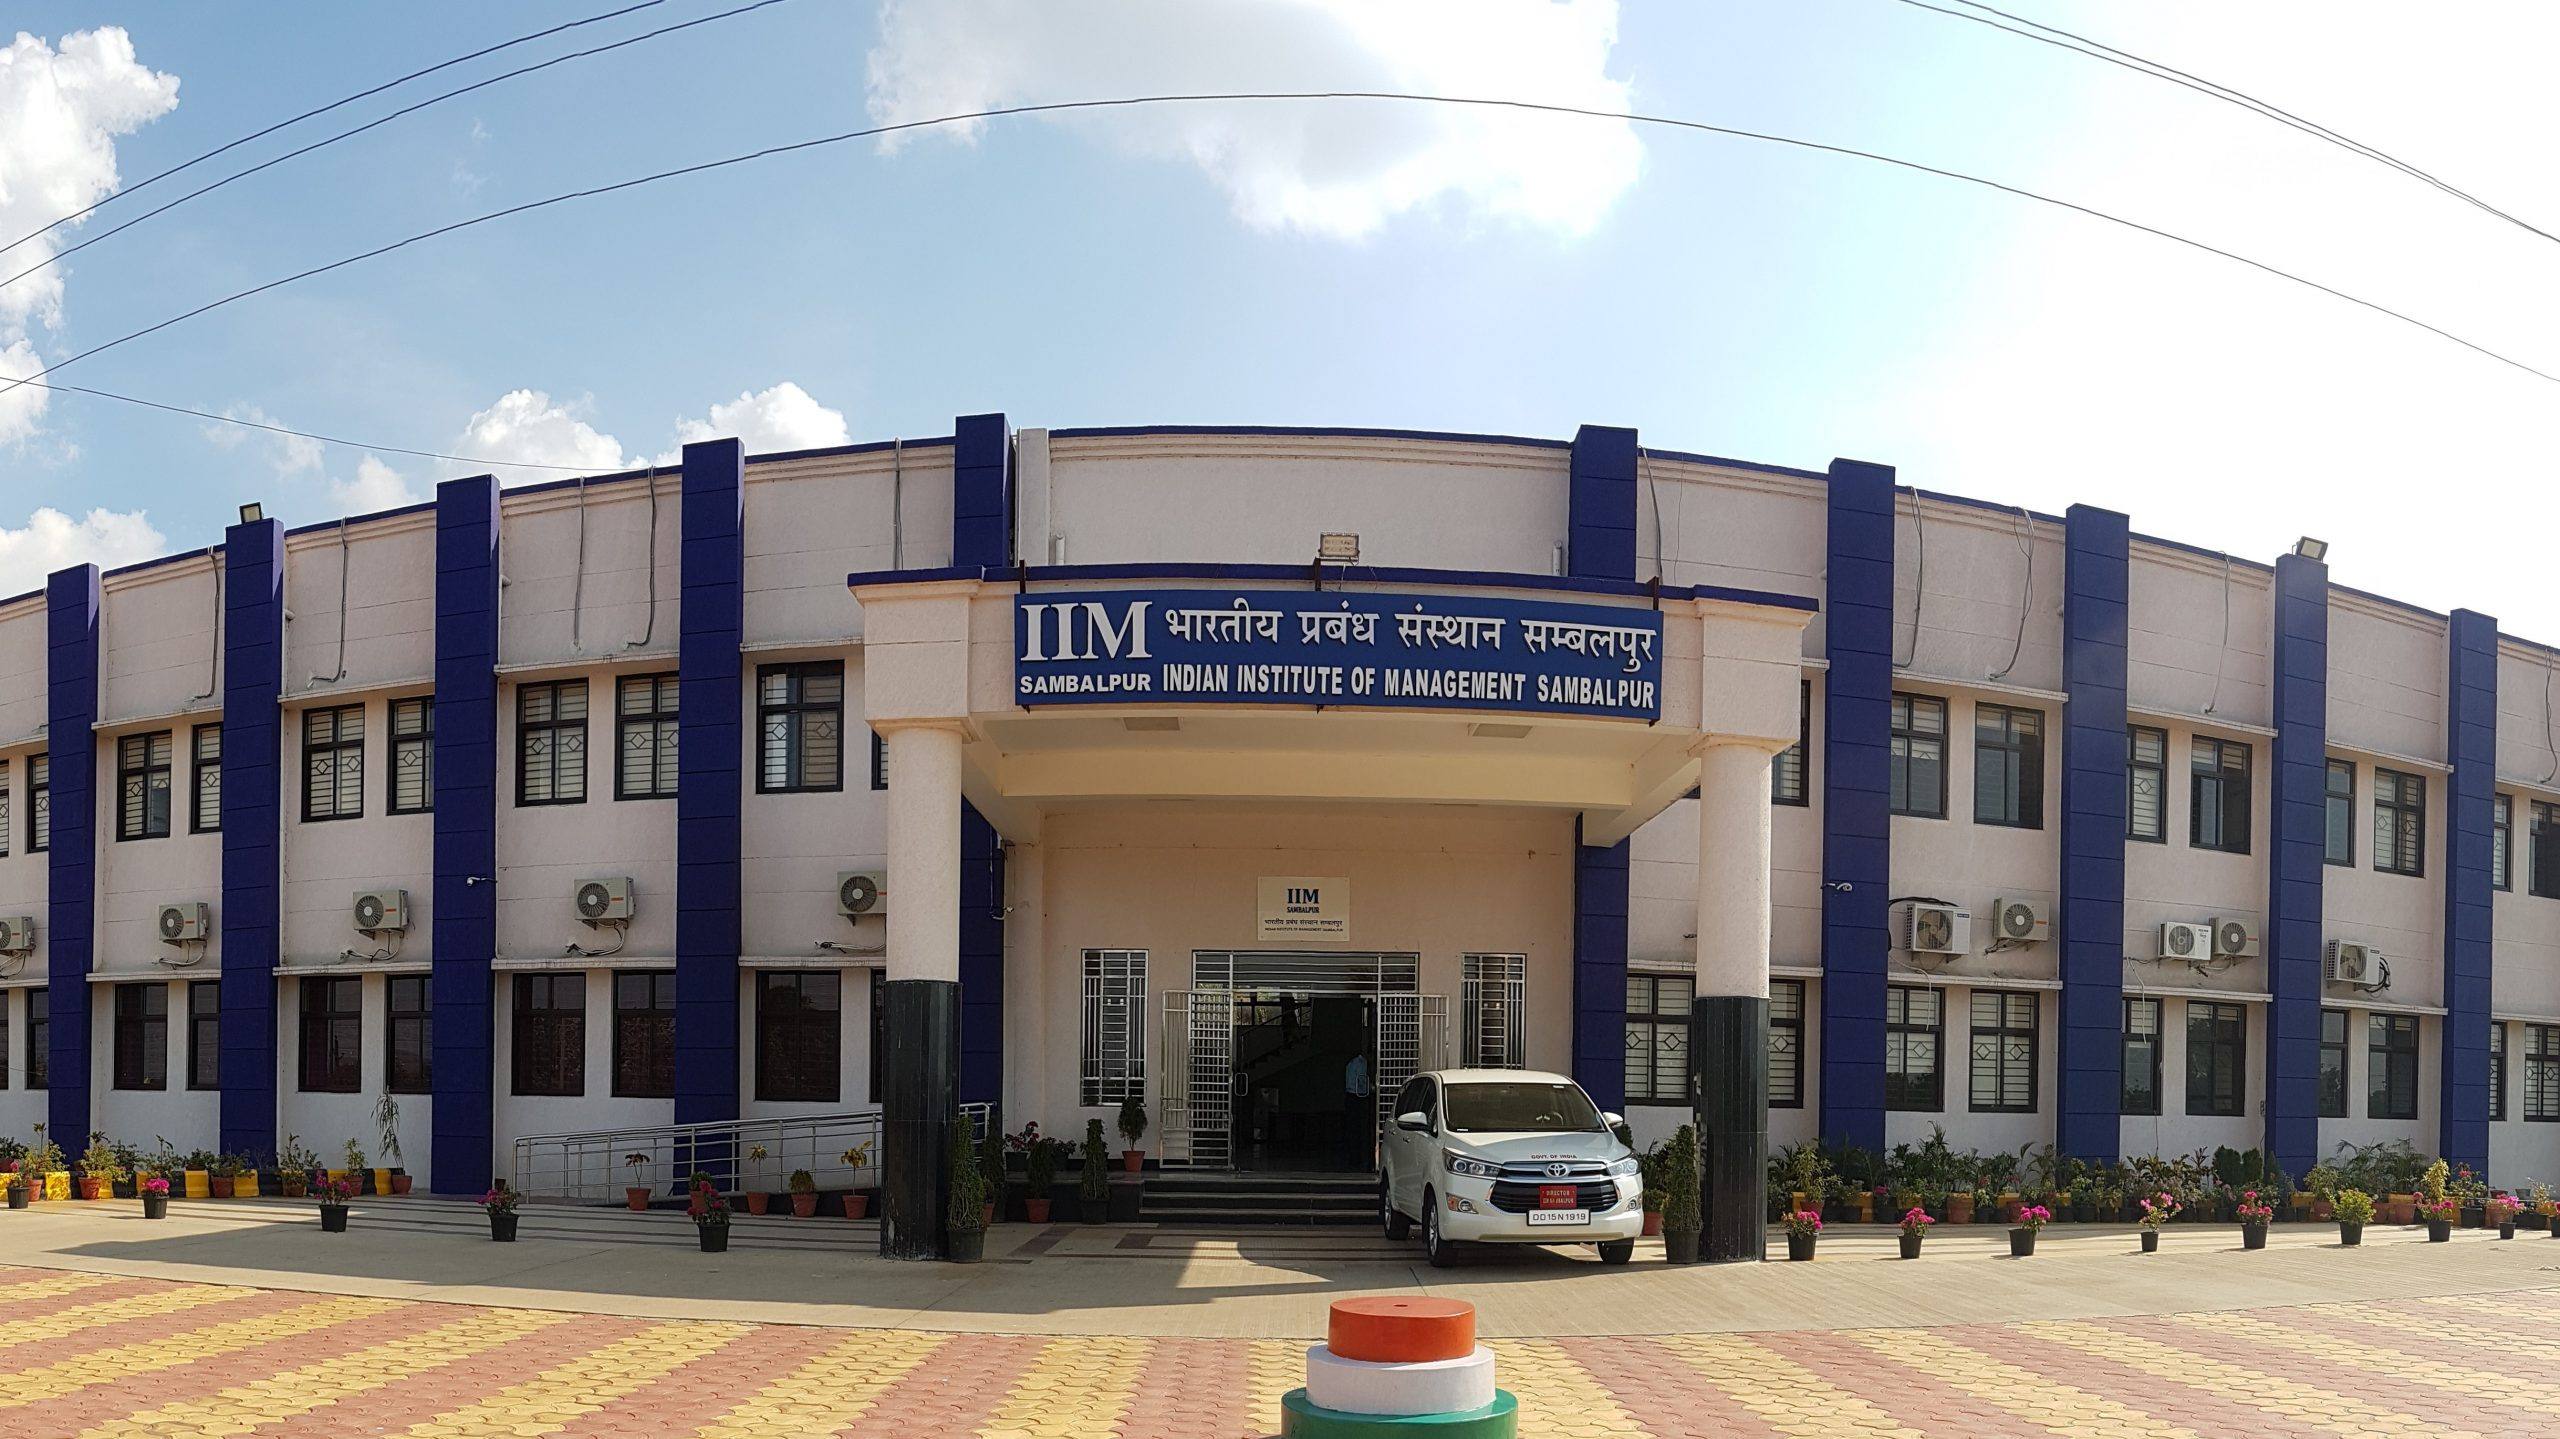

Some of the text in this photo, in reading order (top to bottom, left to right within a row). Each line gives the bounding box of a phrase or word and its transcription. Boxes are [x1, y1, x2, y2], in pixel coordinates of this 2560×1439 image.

[1020, 601, 1152, 662] IIM
[1165, 597, 1656, 673] भारतीय प्रबंध संस्थान सम्बलपुर
[1020, 673, 1151, 694] SAMBALPUR
[1163, 664, 1654, 709] INDIAN INSTITUTE OF MANAGEMENT SAMBALPUR
[1286, 906, 1320, 914] SAMBALPUR
[1287, 888, 1320, 904] IIM
